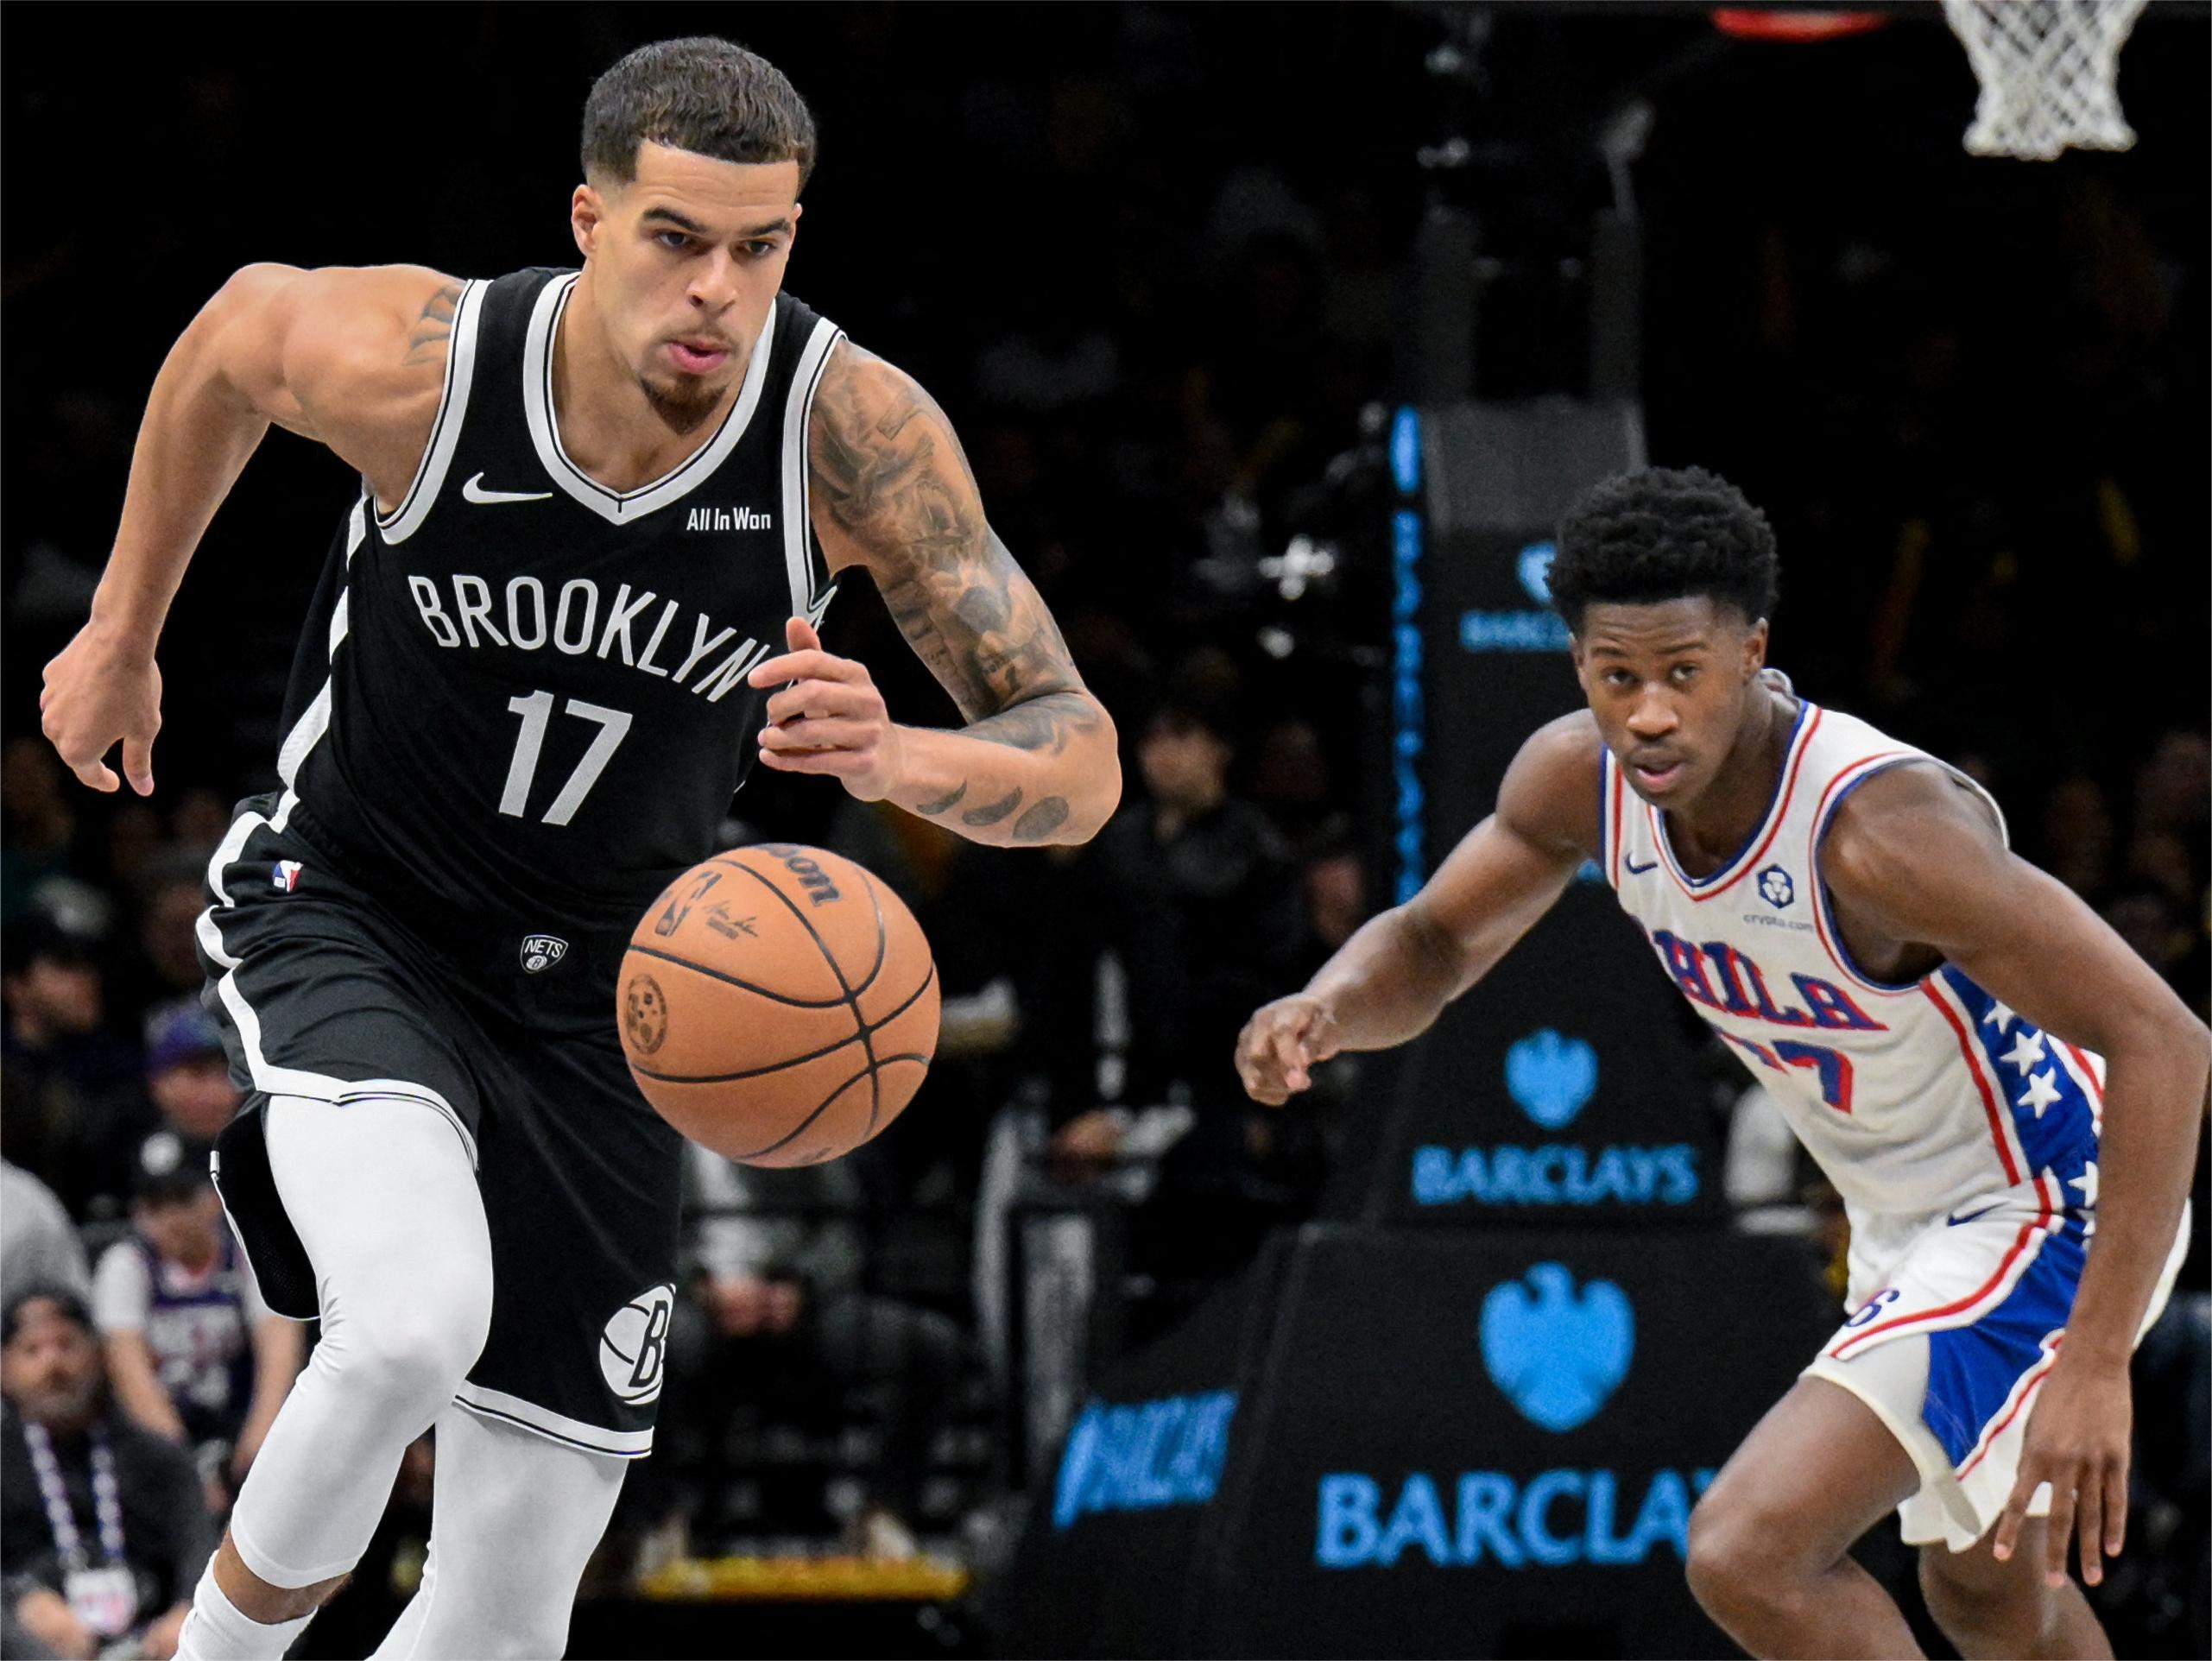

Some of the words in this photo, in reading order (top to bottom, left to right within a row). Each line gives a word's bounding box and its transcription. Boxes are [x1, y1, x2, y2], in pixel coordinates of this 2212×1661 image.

[686, 508, 710, 531] All
[714, 508, 730, 531] In
[733, 507, 771, 530] Won
[408, 574, 770, 703] BROOKLYN
[499, 690, 633, 825] 17
[524, 938, 563, 958] NETS
[1413, 1144, 1701, 1205] BARCLAYS
